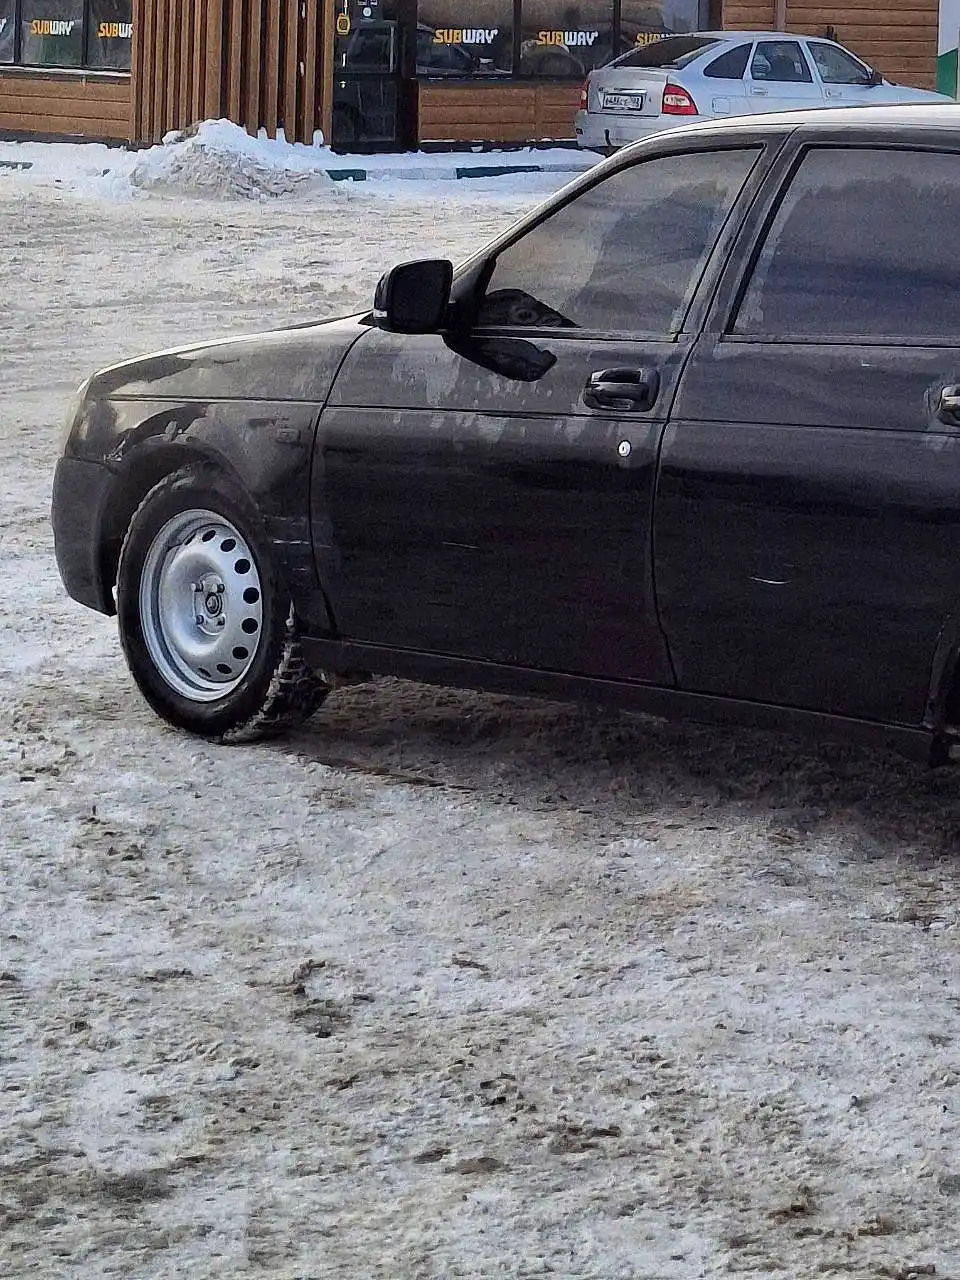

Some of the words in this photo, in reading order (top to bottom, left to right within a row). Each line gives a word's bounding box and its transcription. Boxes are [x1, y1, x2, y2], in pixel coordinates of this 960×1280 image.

[31, 20, 75, 35] SUBWAY
[433, 28, 498, 44] SUBWAY
[537, 31, 598, 46] SUBWAY
